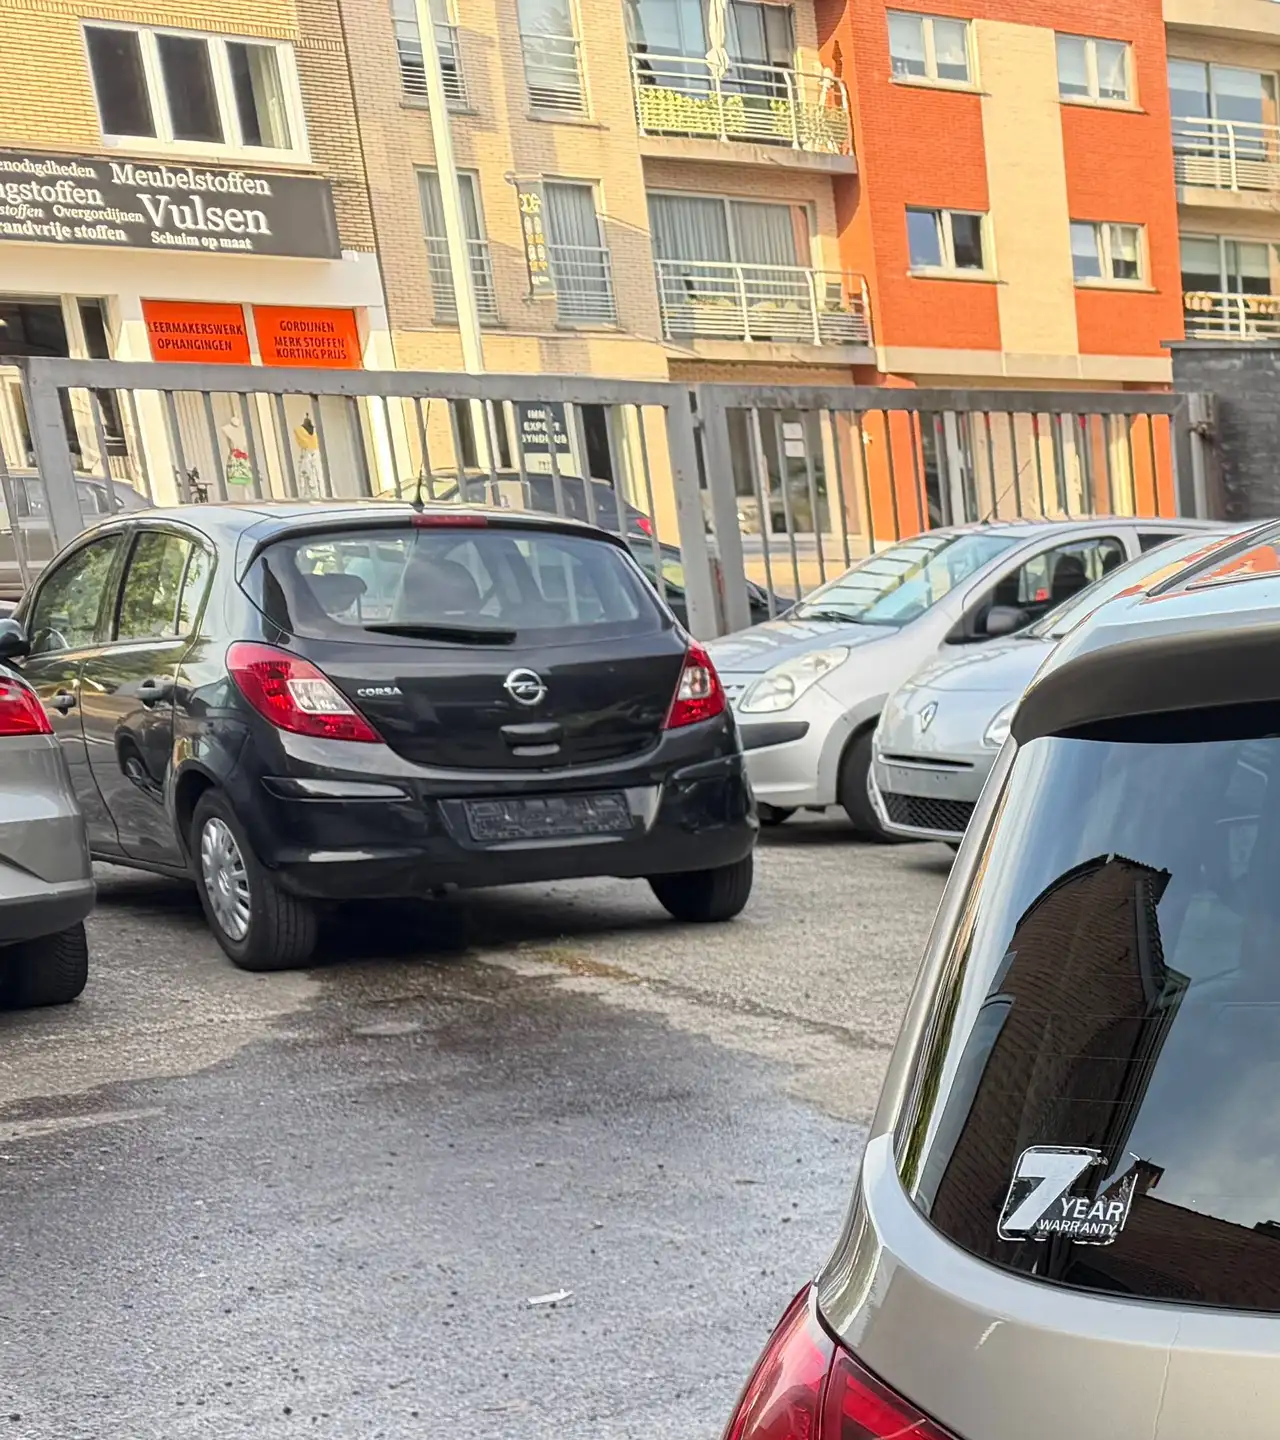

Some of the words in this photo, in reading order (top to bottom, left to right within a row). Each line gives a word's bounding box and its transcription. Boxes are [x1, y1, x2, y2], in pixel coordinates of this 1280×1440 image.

[0, 158, 96, 179] nodigdheden
[109, 163, 271, 196] Meubelstoffen
[53, 205, 146, 224] Overgordijnen
[136, 193, 272, 236] Vulsen
[74, 224, 127, 242] stoffen
[151, 230, 200, 247] Schuim
[201, 236, 219, 250] op
[220, 238, 252, 250] maat
[279, 320, 335, 333] GORDIJNEN
[157, 338, 233, 351] OPHANGINGEN
[274, 336, 302, 347] MERK
[304, 337, 345, 349] STOFFEN
[276, 348, 319, 360] KORTING
[320, 350, 347, 360] PRIJS
[527, 409, 554, 420] IMM
[357, 687, 403, 697] CORSA
[1001, 1152, 1093, 1230] 7
[1060, 1197, 1125, 1222] YEAR
[1039, 1219, 1118, 1235] WARRANTY
